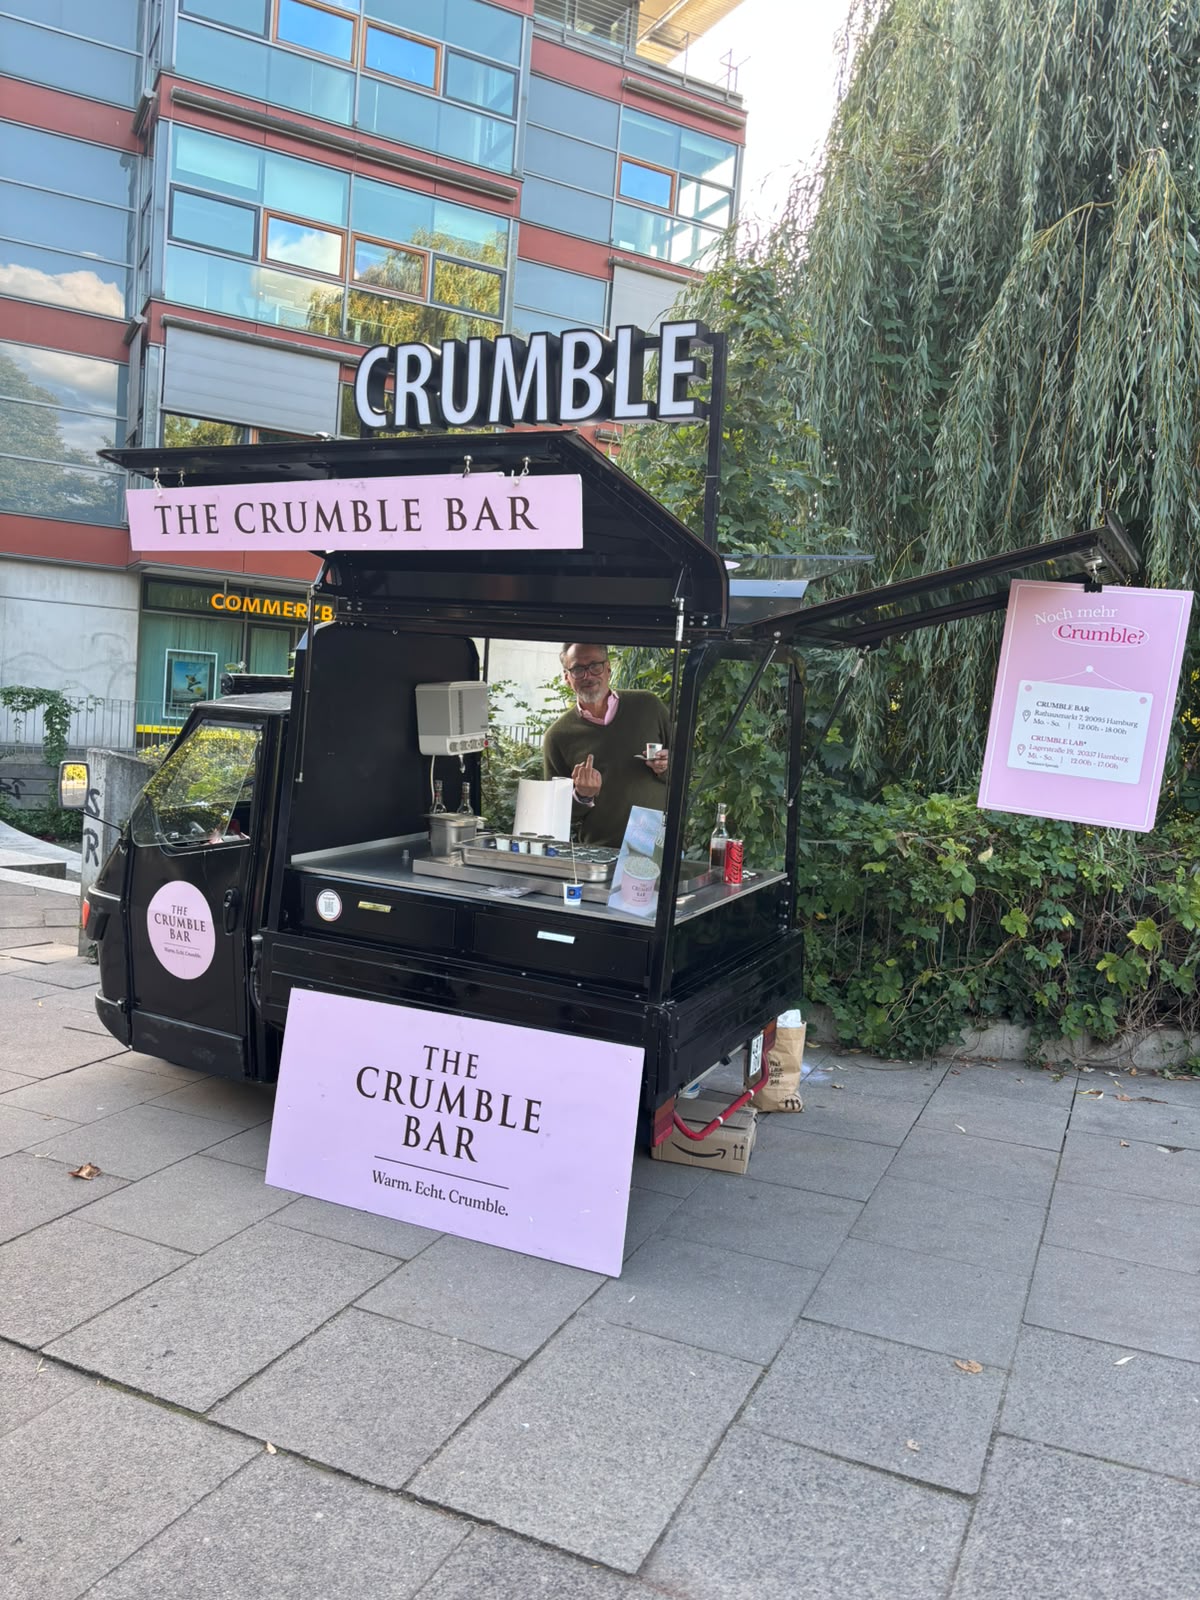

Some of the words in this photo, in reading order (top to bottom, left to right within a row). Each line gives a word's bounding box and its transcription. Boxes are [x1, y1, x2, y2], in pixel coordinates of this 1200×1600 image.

[355, 320, 700, 428] CRUMBLE
[153, 503, 220, 535] THE
[233, 498, 422, 534] CRUMBLE
[443, 495, 540, 533] BAR
[1034, 607, 1073, 625] Noch
[1077, 604, 1118, 618] mehr
[1057, 623, 1146, 645] Crumble?
[1036, 700, 1074, 711] CRUMBLE
[1074, 705, 1090, 713] BAR
[1106, 718, 1139, 729] Hamburg
[1030, 734, 1069, 746] CRUMBLE
[1097, 751, 1129, 763] Hamburg
[171, 904, 188, 916] THE
[154, 912, 206, 932] CRUMBLE
[169, 928, 191, 943] BAR
[423, 1045, 479, 1080] THE
[355, 1065, 542, 1134] CRUMBLE
[401, 1114, 479, 1163] BAR
[372, 1169, 413, 1192] Warm.
[414, 1180, 446, 1201] Echt.
[448, 1189, 509, 1217] Crumble.
